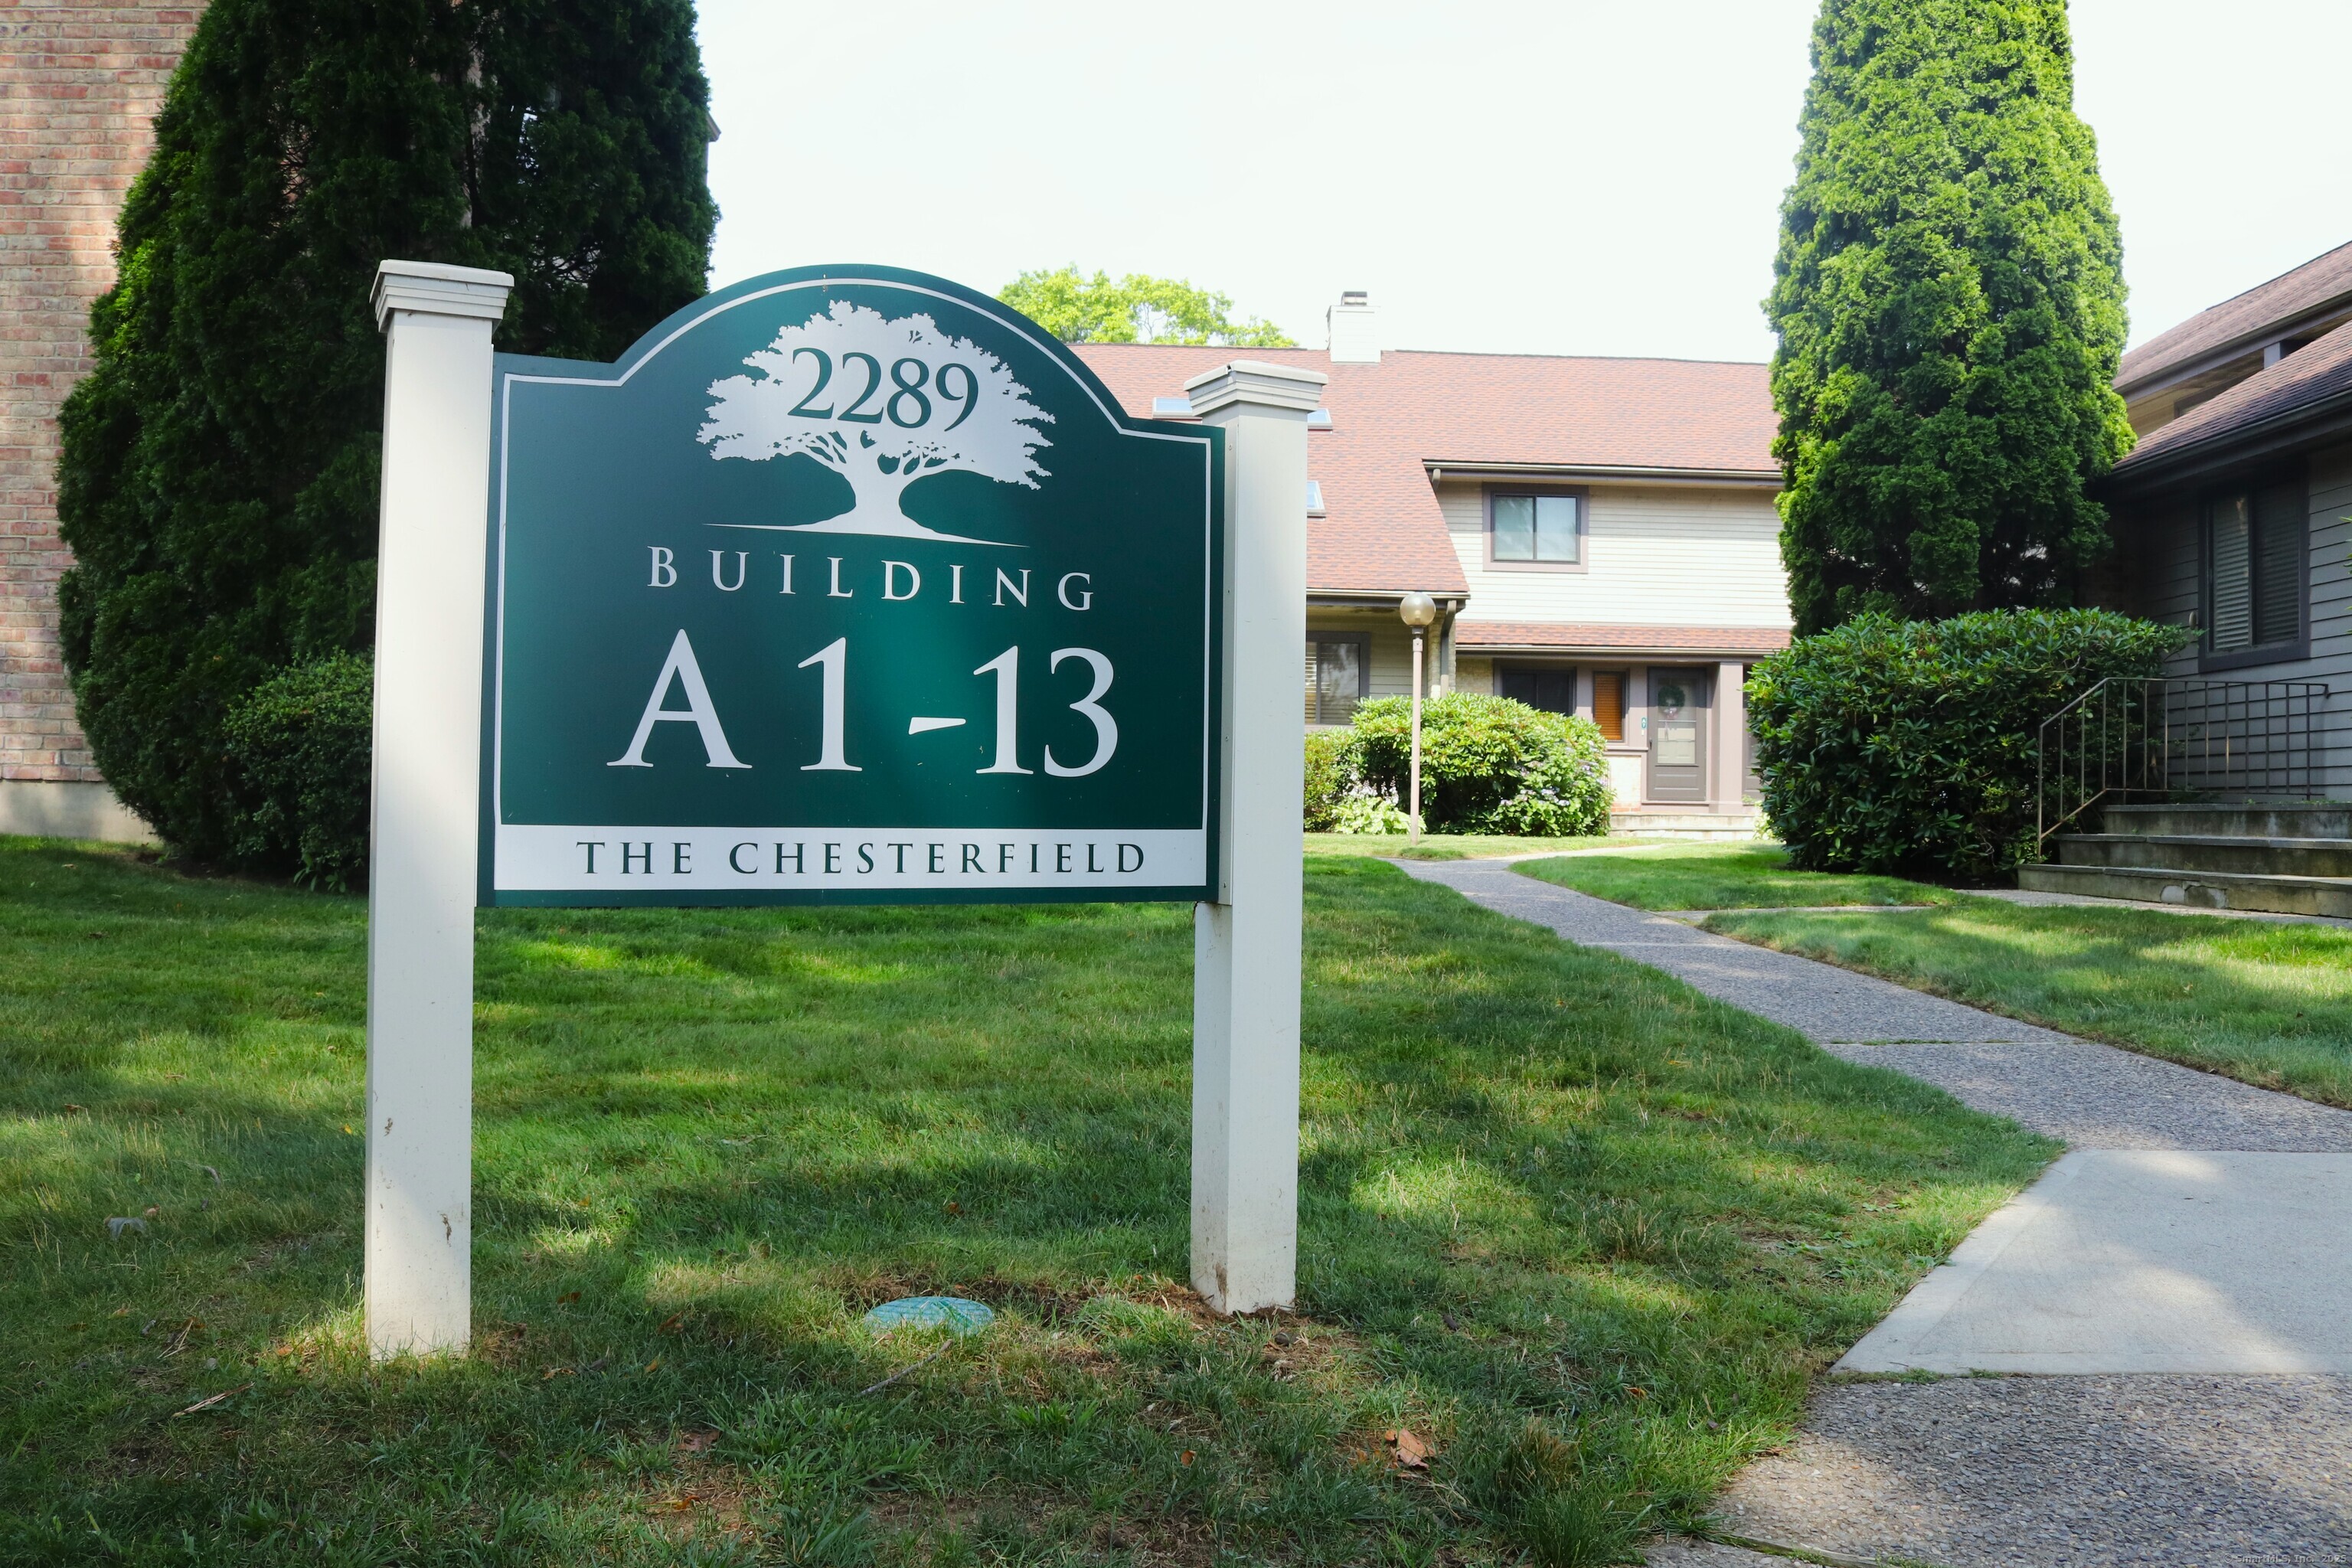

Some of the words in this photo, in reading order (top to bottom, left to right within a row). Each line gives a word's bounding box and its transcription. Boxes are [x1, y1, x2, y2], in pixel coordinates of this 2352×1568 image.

[788, 347, 979, 433] 2289
[647, 546, 1094, 611] BUILDING
[576, 841, 692, 874] THE
[729, 841, 1145, 874] CHESTERFIELD
